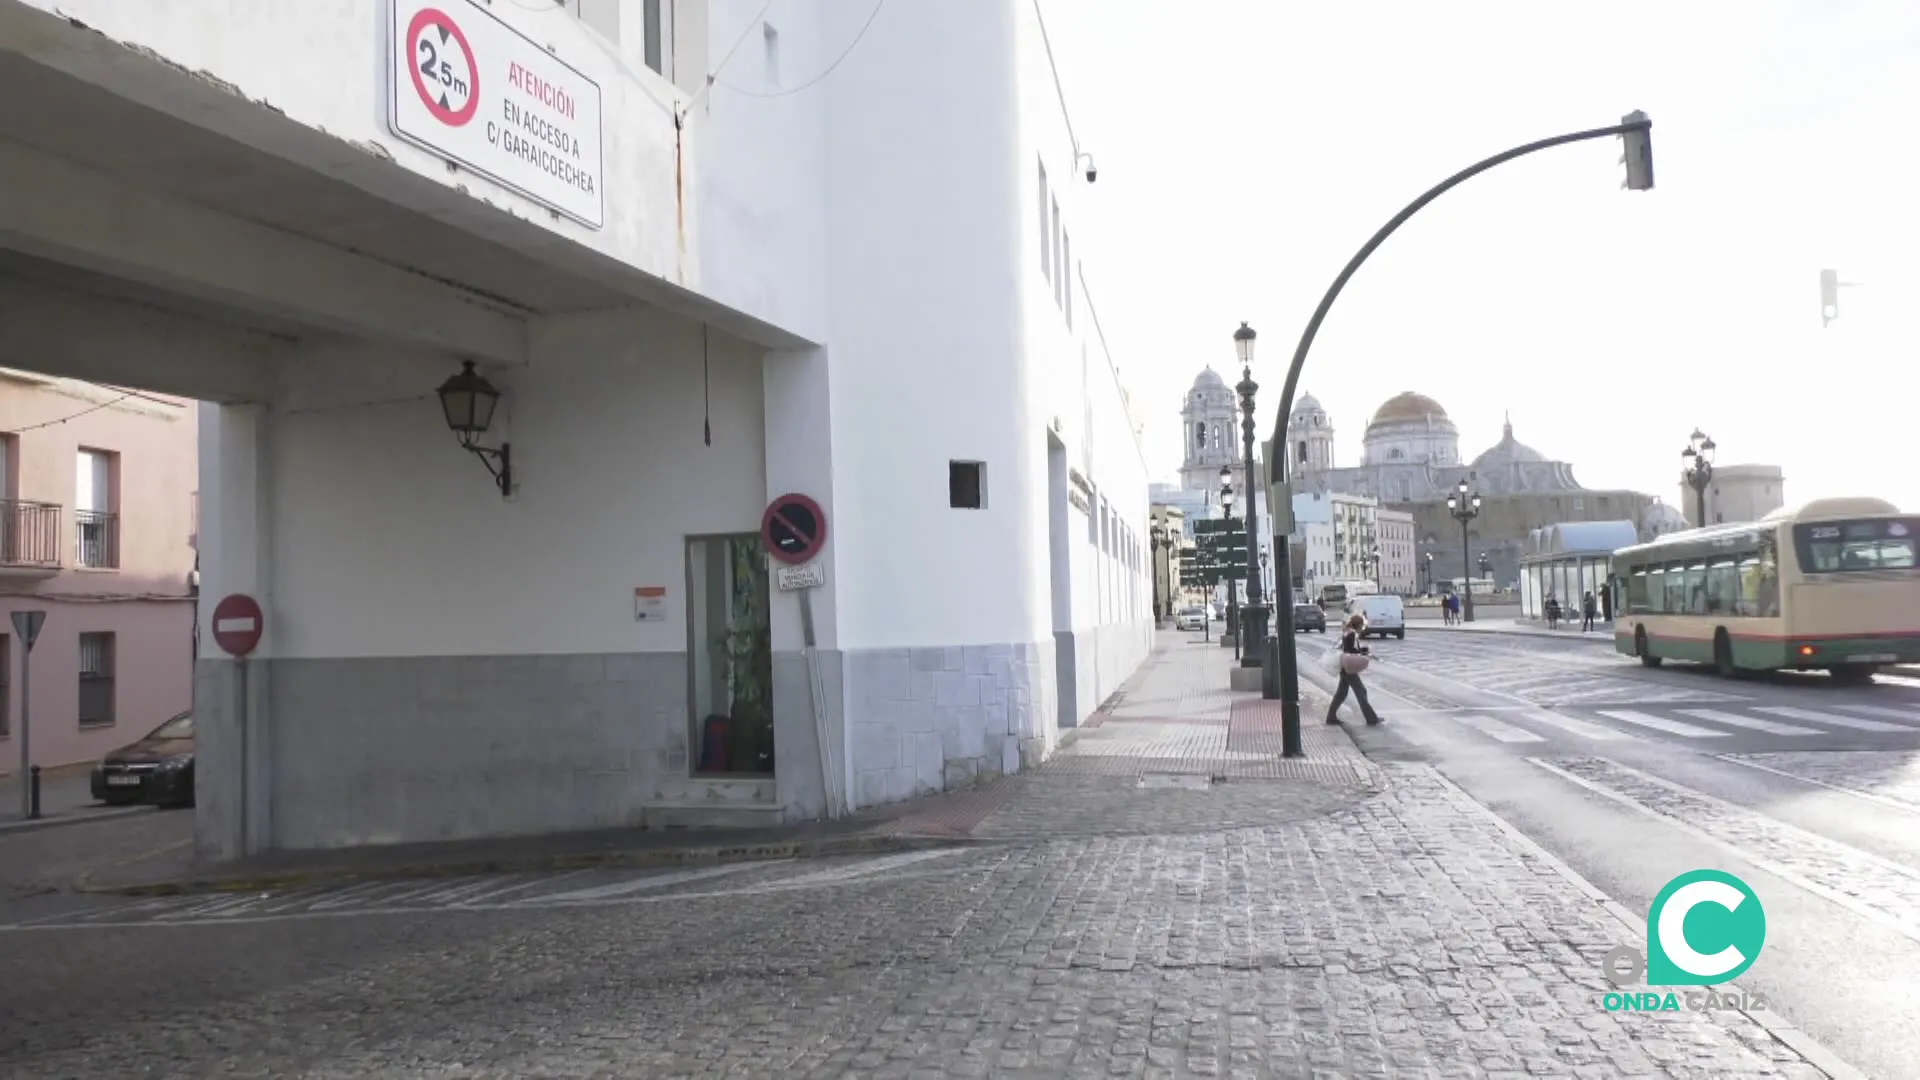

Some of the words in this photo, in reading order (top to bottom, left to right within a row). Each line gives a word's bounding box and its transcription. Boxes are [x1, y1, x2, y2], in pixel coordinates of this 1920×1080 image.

[508, 61, 575, 120] ATENCIÓN
[487, 121, 500, 149] C/
[503, 129, 595, 195] GARAICOECHEA
[504, 99, 520, 126] EN
[523, 110, 569, 153] ACCESO
[572, 138, 580, 160] A
